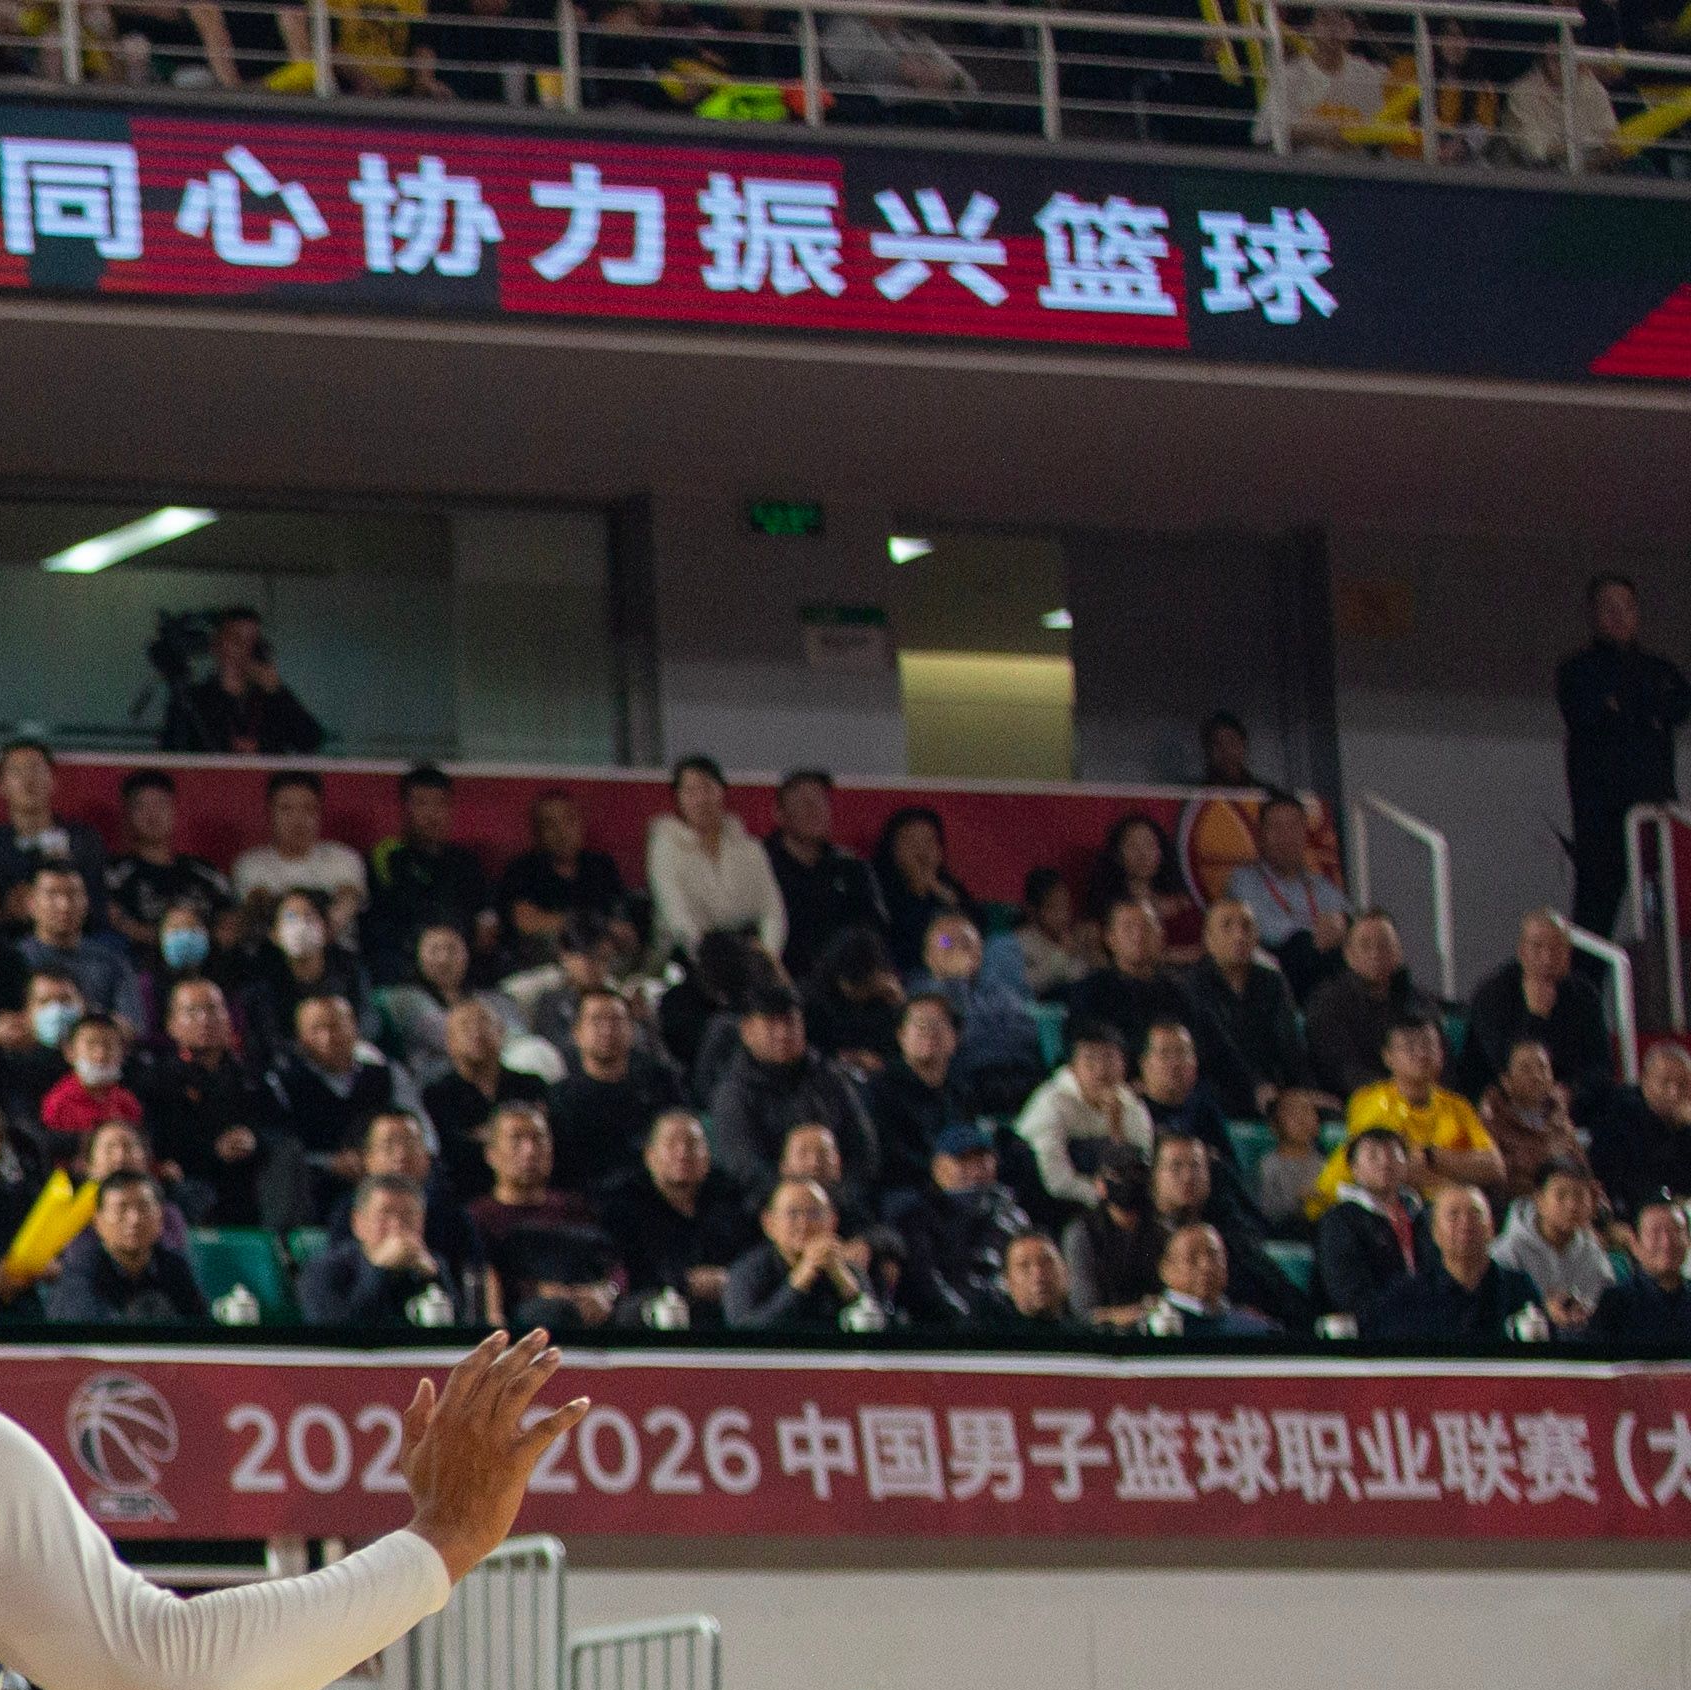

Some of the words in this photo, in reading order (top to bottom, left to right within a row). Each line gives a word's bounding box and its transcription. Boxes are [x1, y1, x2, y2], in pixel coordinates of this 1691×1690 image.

[0, 136, 1338, 322] 同心协力振兴篮球
